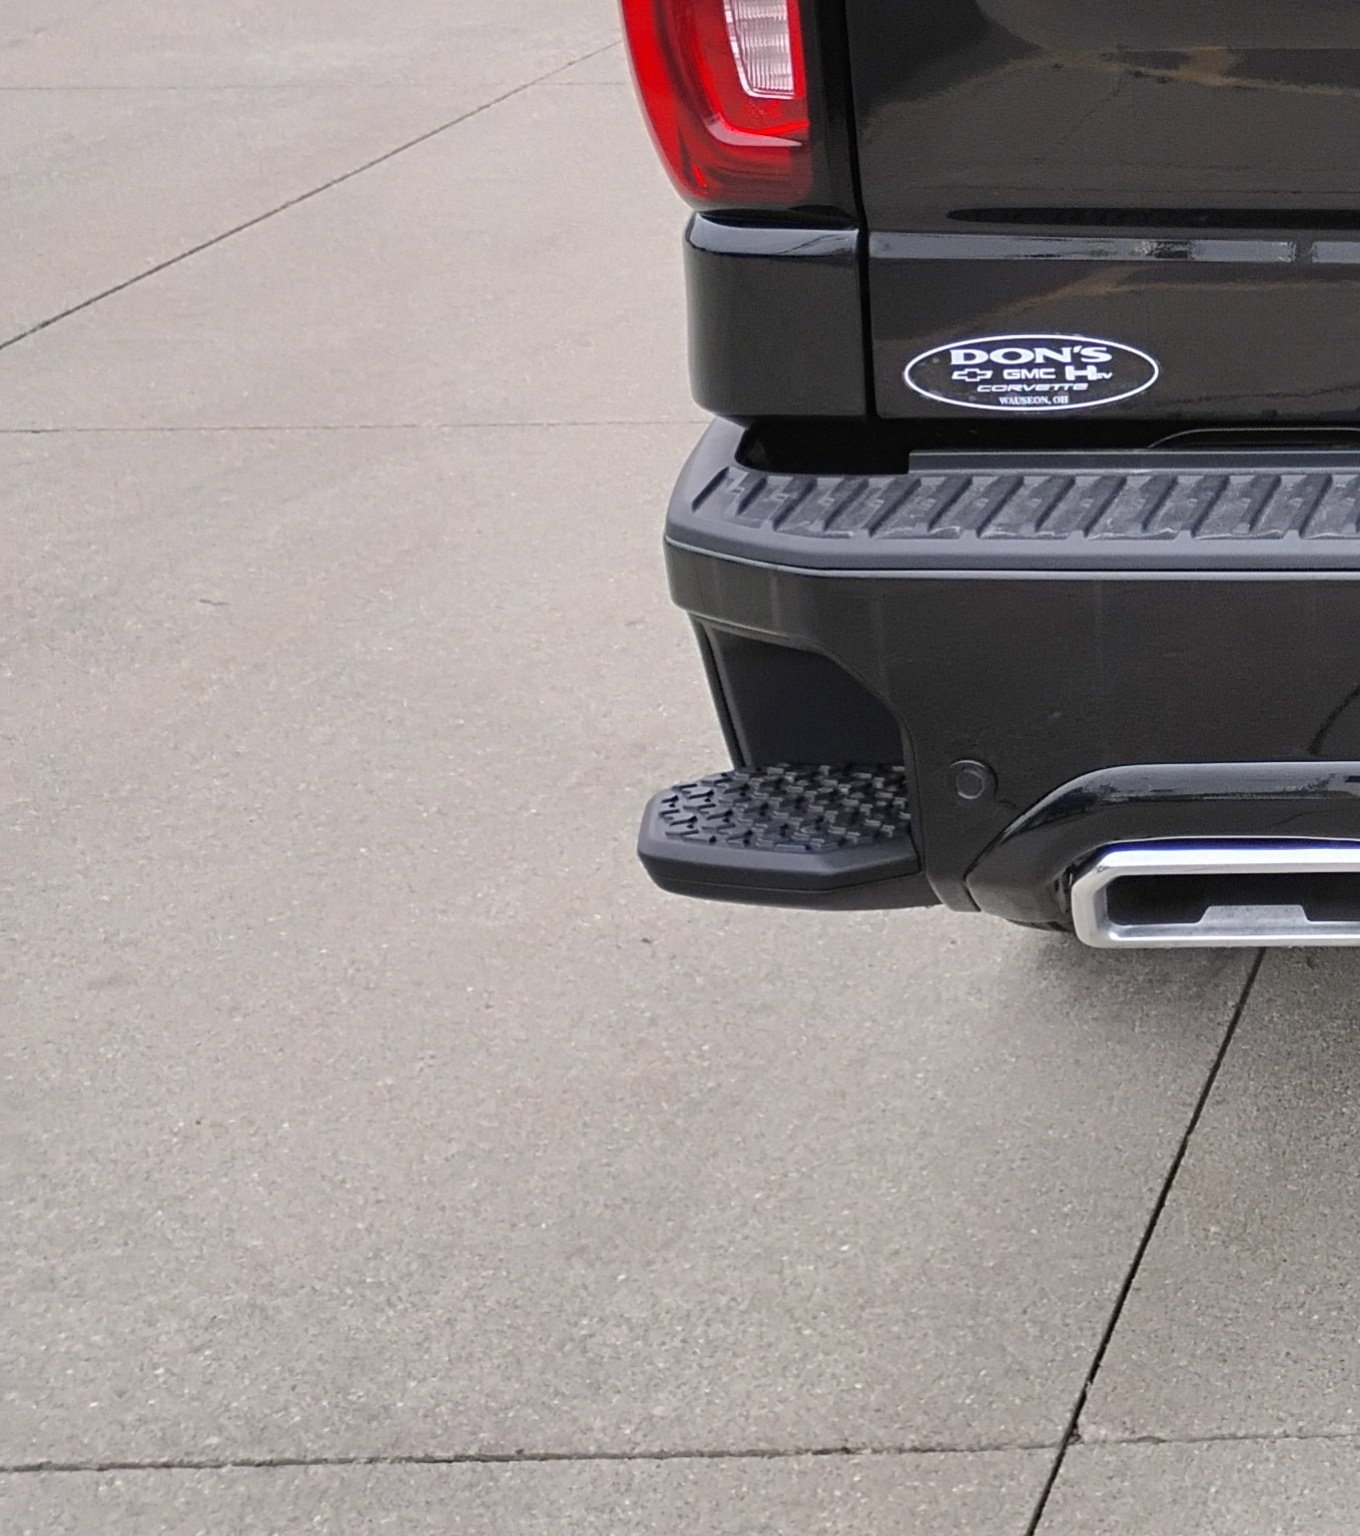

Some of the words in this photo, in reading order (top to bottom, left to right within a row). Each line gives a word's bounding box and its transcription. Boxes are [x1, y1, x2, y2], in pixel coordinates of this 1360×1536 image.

[950, 345, 1112, 365] DON'S
[1002, 368, 1056, 380] GMC
[976, 382, 1089, 393] CORVETTE
[998, 395, 1052, 405] WAUSEON,
[1053, 395, 1069, 404] OH
